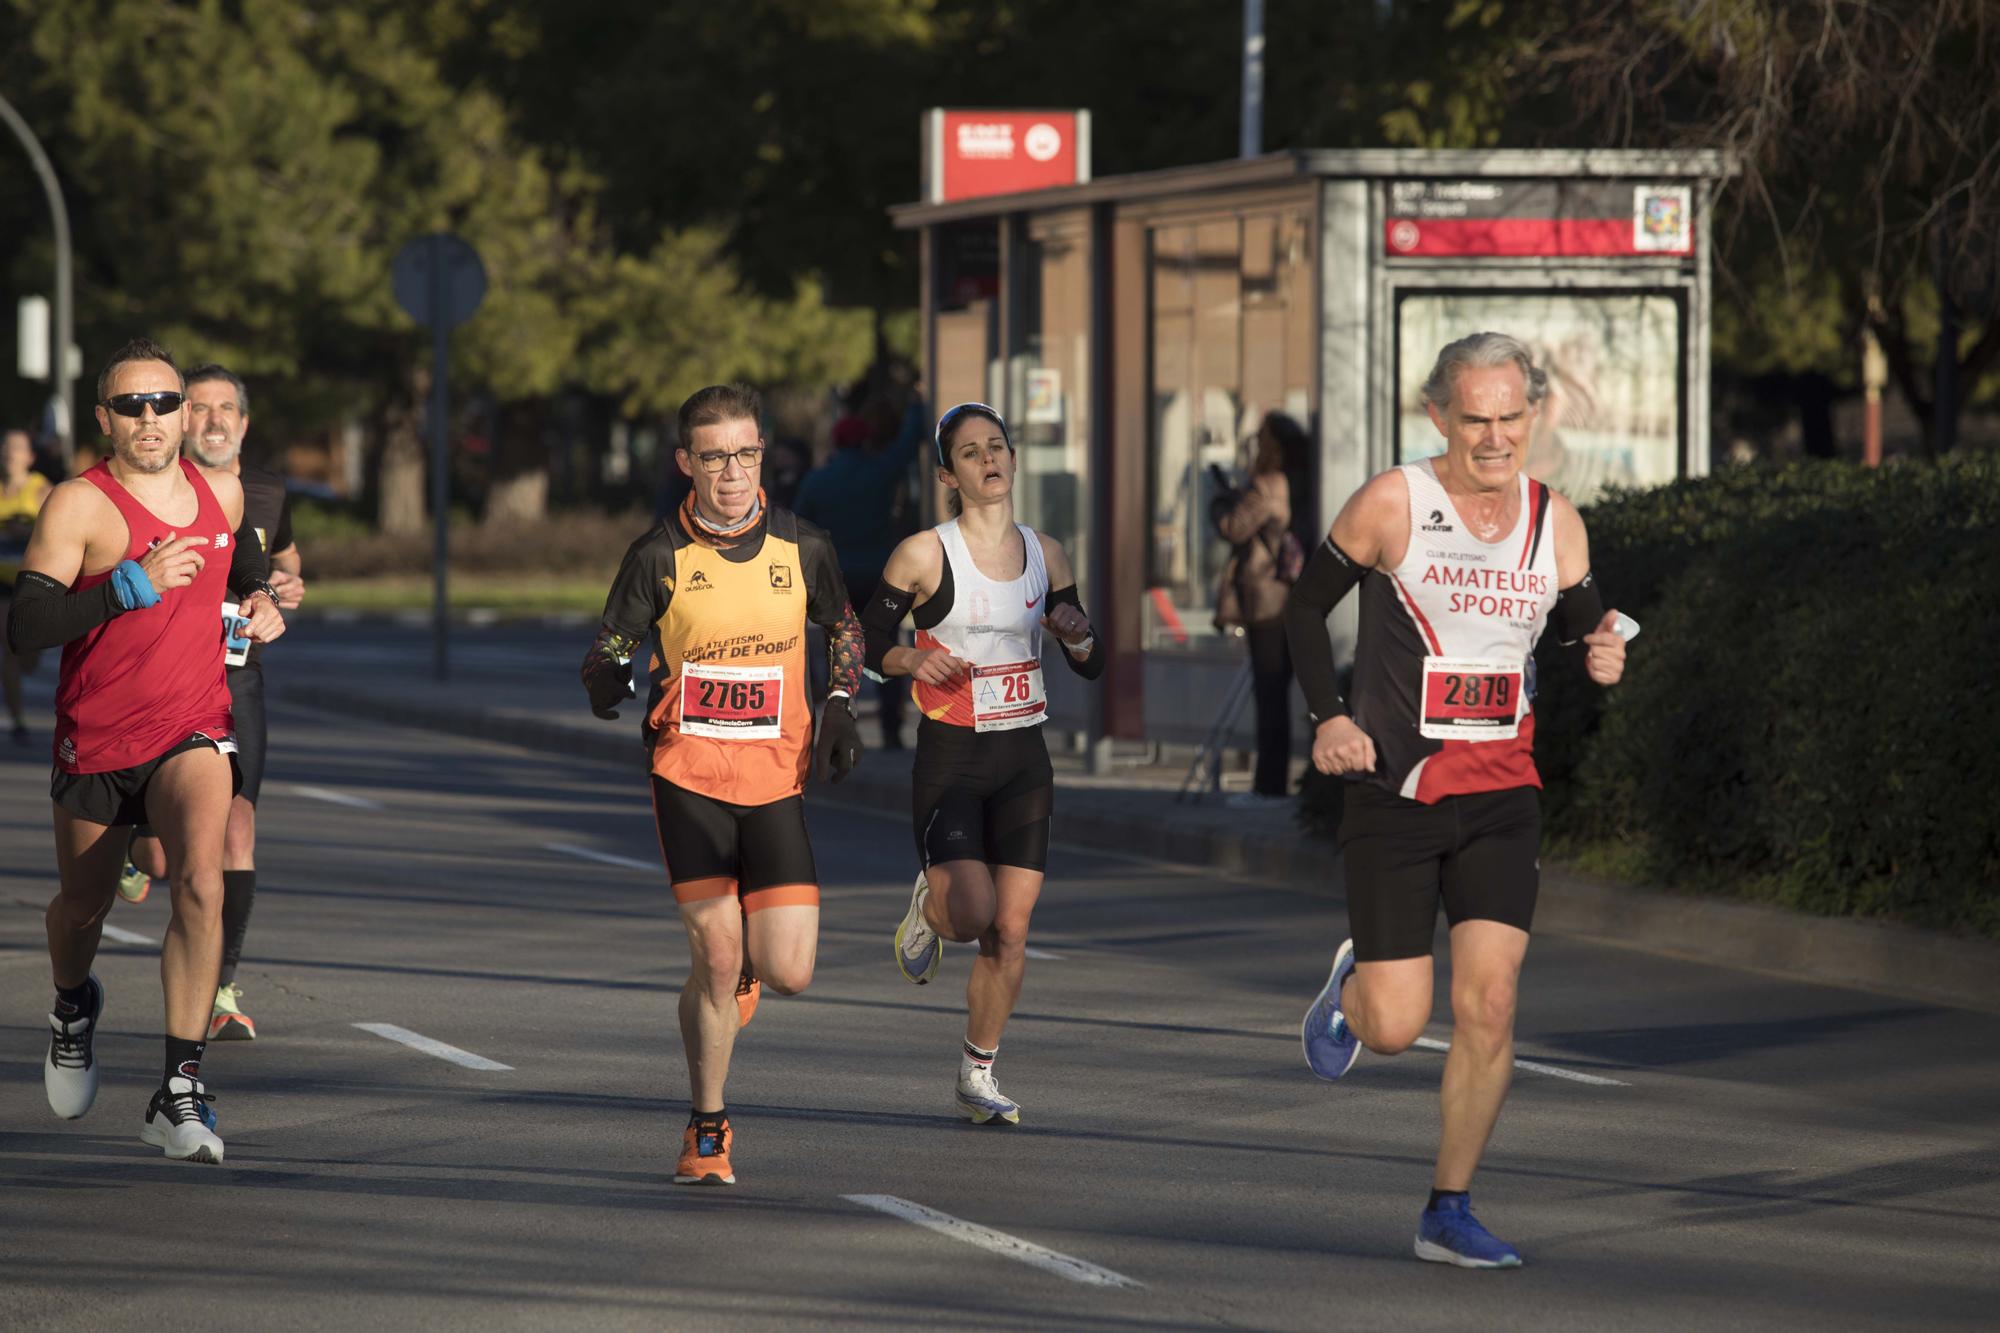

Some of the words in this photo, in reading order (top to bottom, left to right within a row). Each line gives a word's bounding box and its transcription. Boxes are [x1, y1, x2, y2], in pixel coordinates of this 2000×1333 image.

[1426, 550, 1446, 559] CLUB
[1447, 551, 1487, 562] ATLETISMO
[1422, 564, 1547, 595] AMATEURS
[1449, 592, 1538, 622] SPORTS
[706, 633, 764, 650] ATLETISMO
[730, 645, 751, 658] DE
[755, 635, 799, 655] POBLET
[699, 680, 764, 710] 2765
[979, 680, 998, 703] A
[1002, 673, 1030, 703] 26
[1443, 675, 1509, 706] 2879
